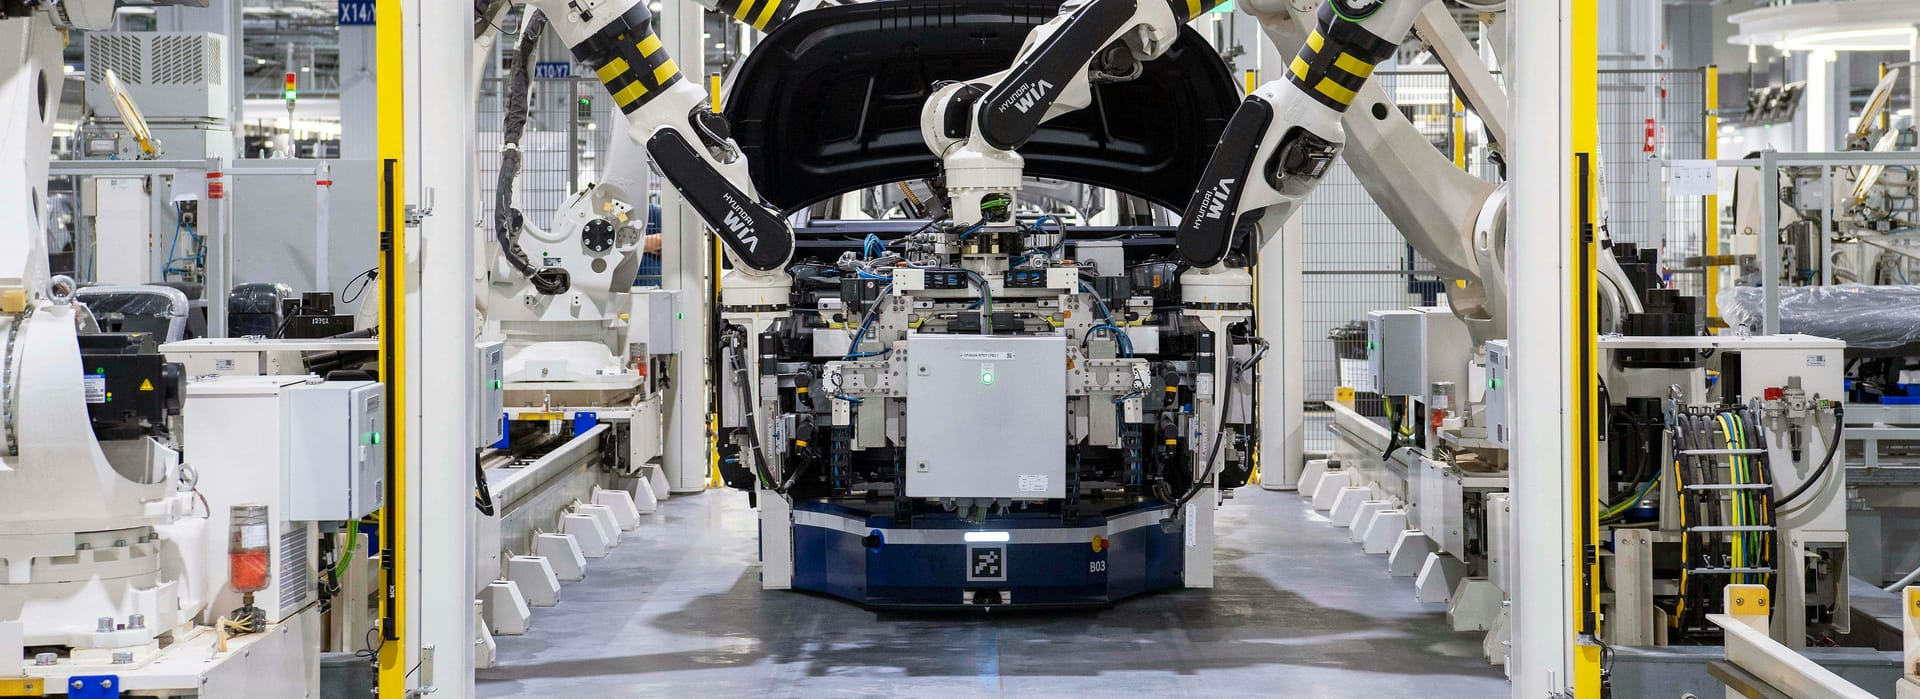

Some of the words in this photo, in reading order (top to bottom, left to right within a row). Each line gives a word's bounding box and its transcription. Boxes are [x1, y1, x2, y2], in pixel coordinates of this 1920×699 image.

[998, 82, 1030, 113] HYUNDAI
[723, 192, 754, 226] HYUNDAI
[1193, 190, 1213, 230] HYUNDAI
[1090, 560, 1106, 572] B03
